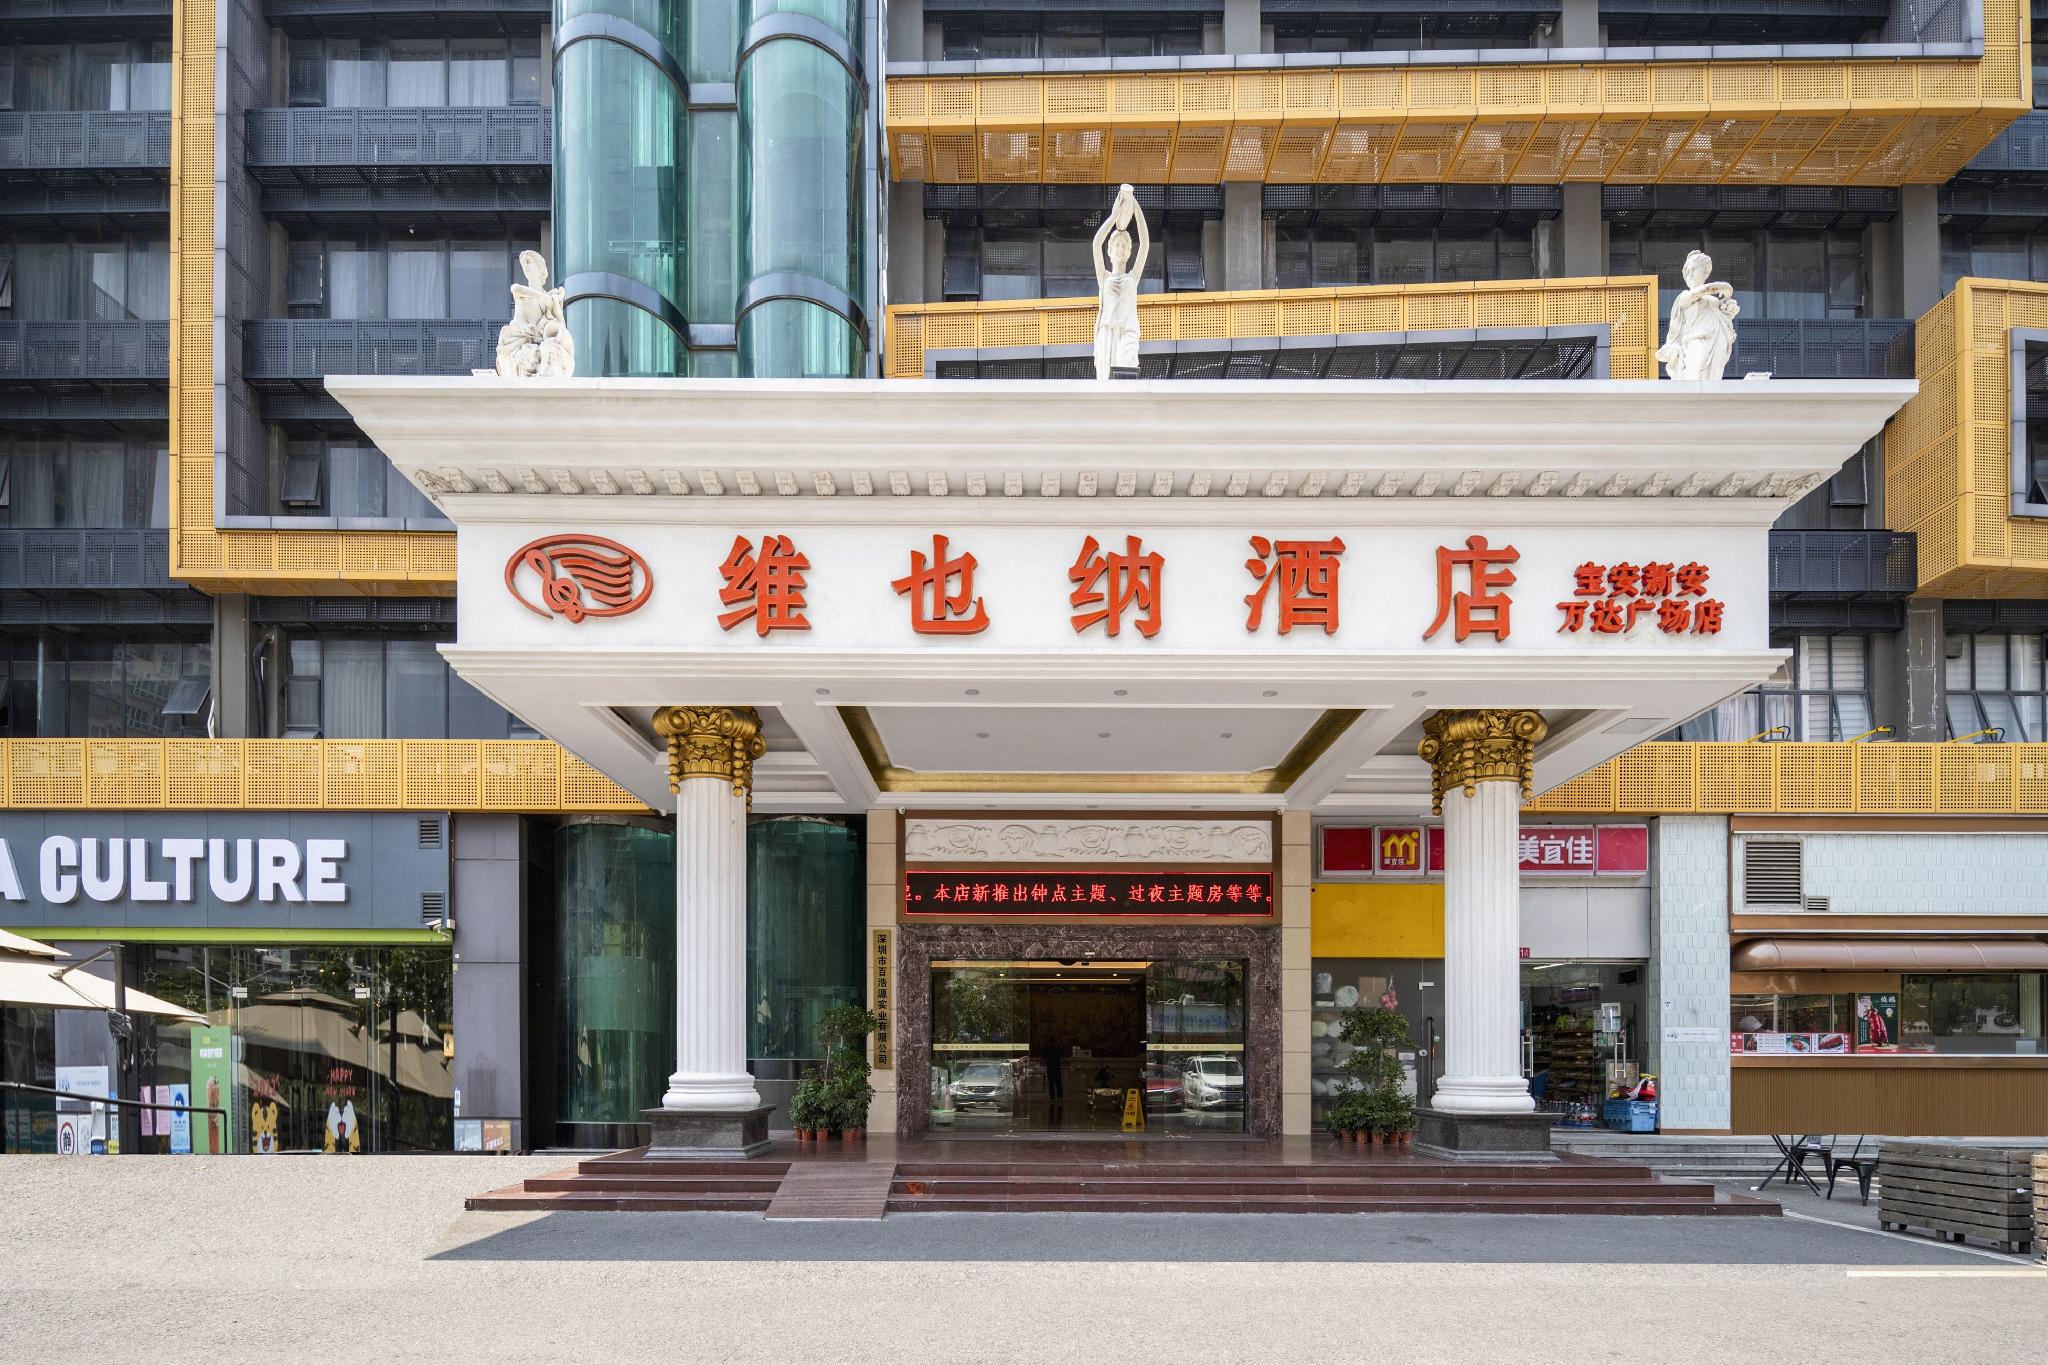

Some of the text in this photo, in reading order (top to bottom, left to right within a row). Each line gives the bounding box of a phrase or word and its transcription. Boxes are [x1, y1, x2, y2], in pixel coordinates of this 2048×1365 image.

[718, 533, 1521, 641] 维也纳酒店
[1573, 561, 1710, 598] 宝安新安
[1556, 598, 1726, 635] 万达广场店
[1519, 834, 1593, 865] 美宜佳
[40, 835, 348, 904] CULTURE
[877, 934, 888, 1065] 深圳市百浩源实业有限公司
[330, 1067, 353, 1083] HAPPY
